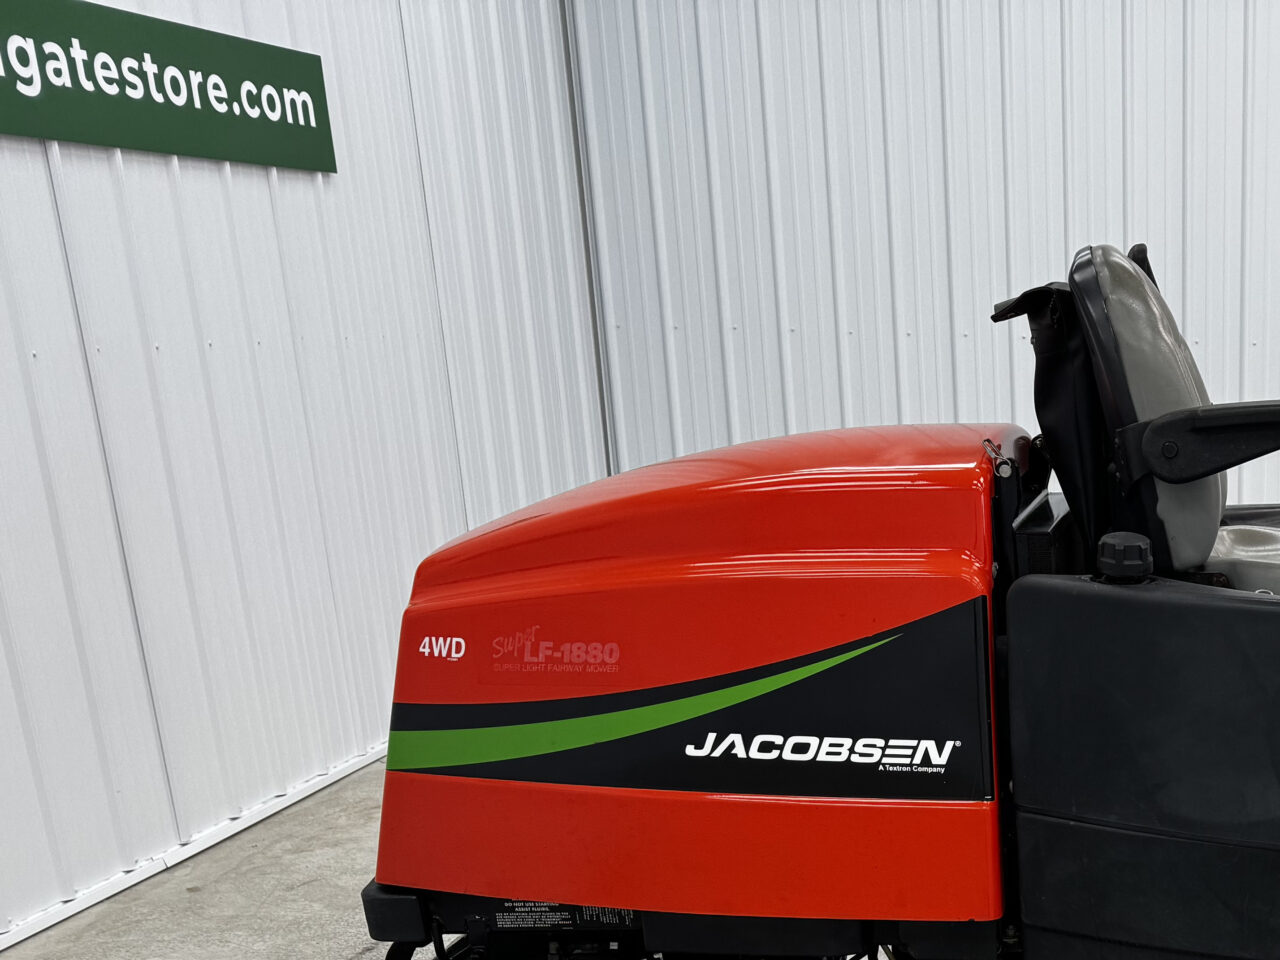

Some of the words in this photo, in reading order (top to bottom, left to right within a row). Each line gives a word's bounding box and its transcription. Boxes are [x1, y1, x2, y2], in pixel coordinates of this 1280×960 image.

[0, 34, 317, 128] gatestore.com
[418, 636, 466, 658] 4WD
[523, 641, 620, 664] LF-1880
[685, 732, 955, 765] JACOBSEN
[912, 765, 945, 774] Company
